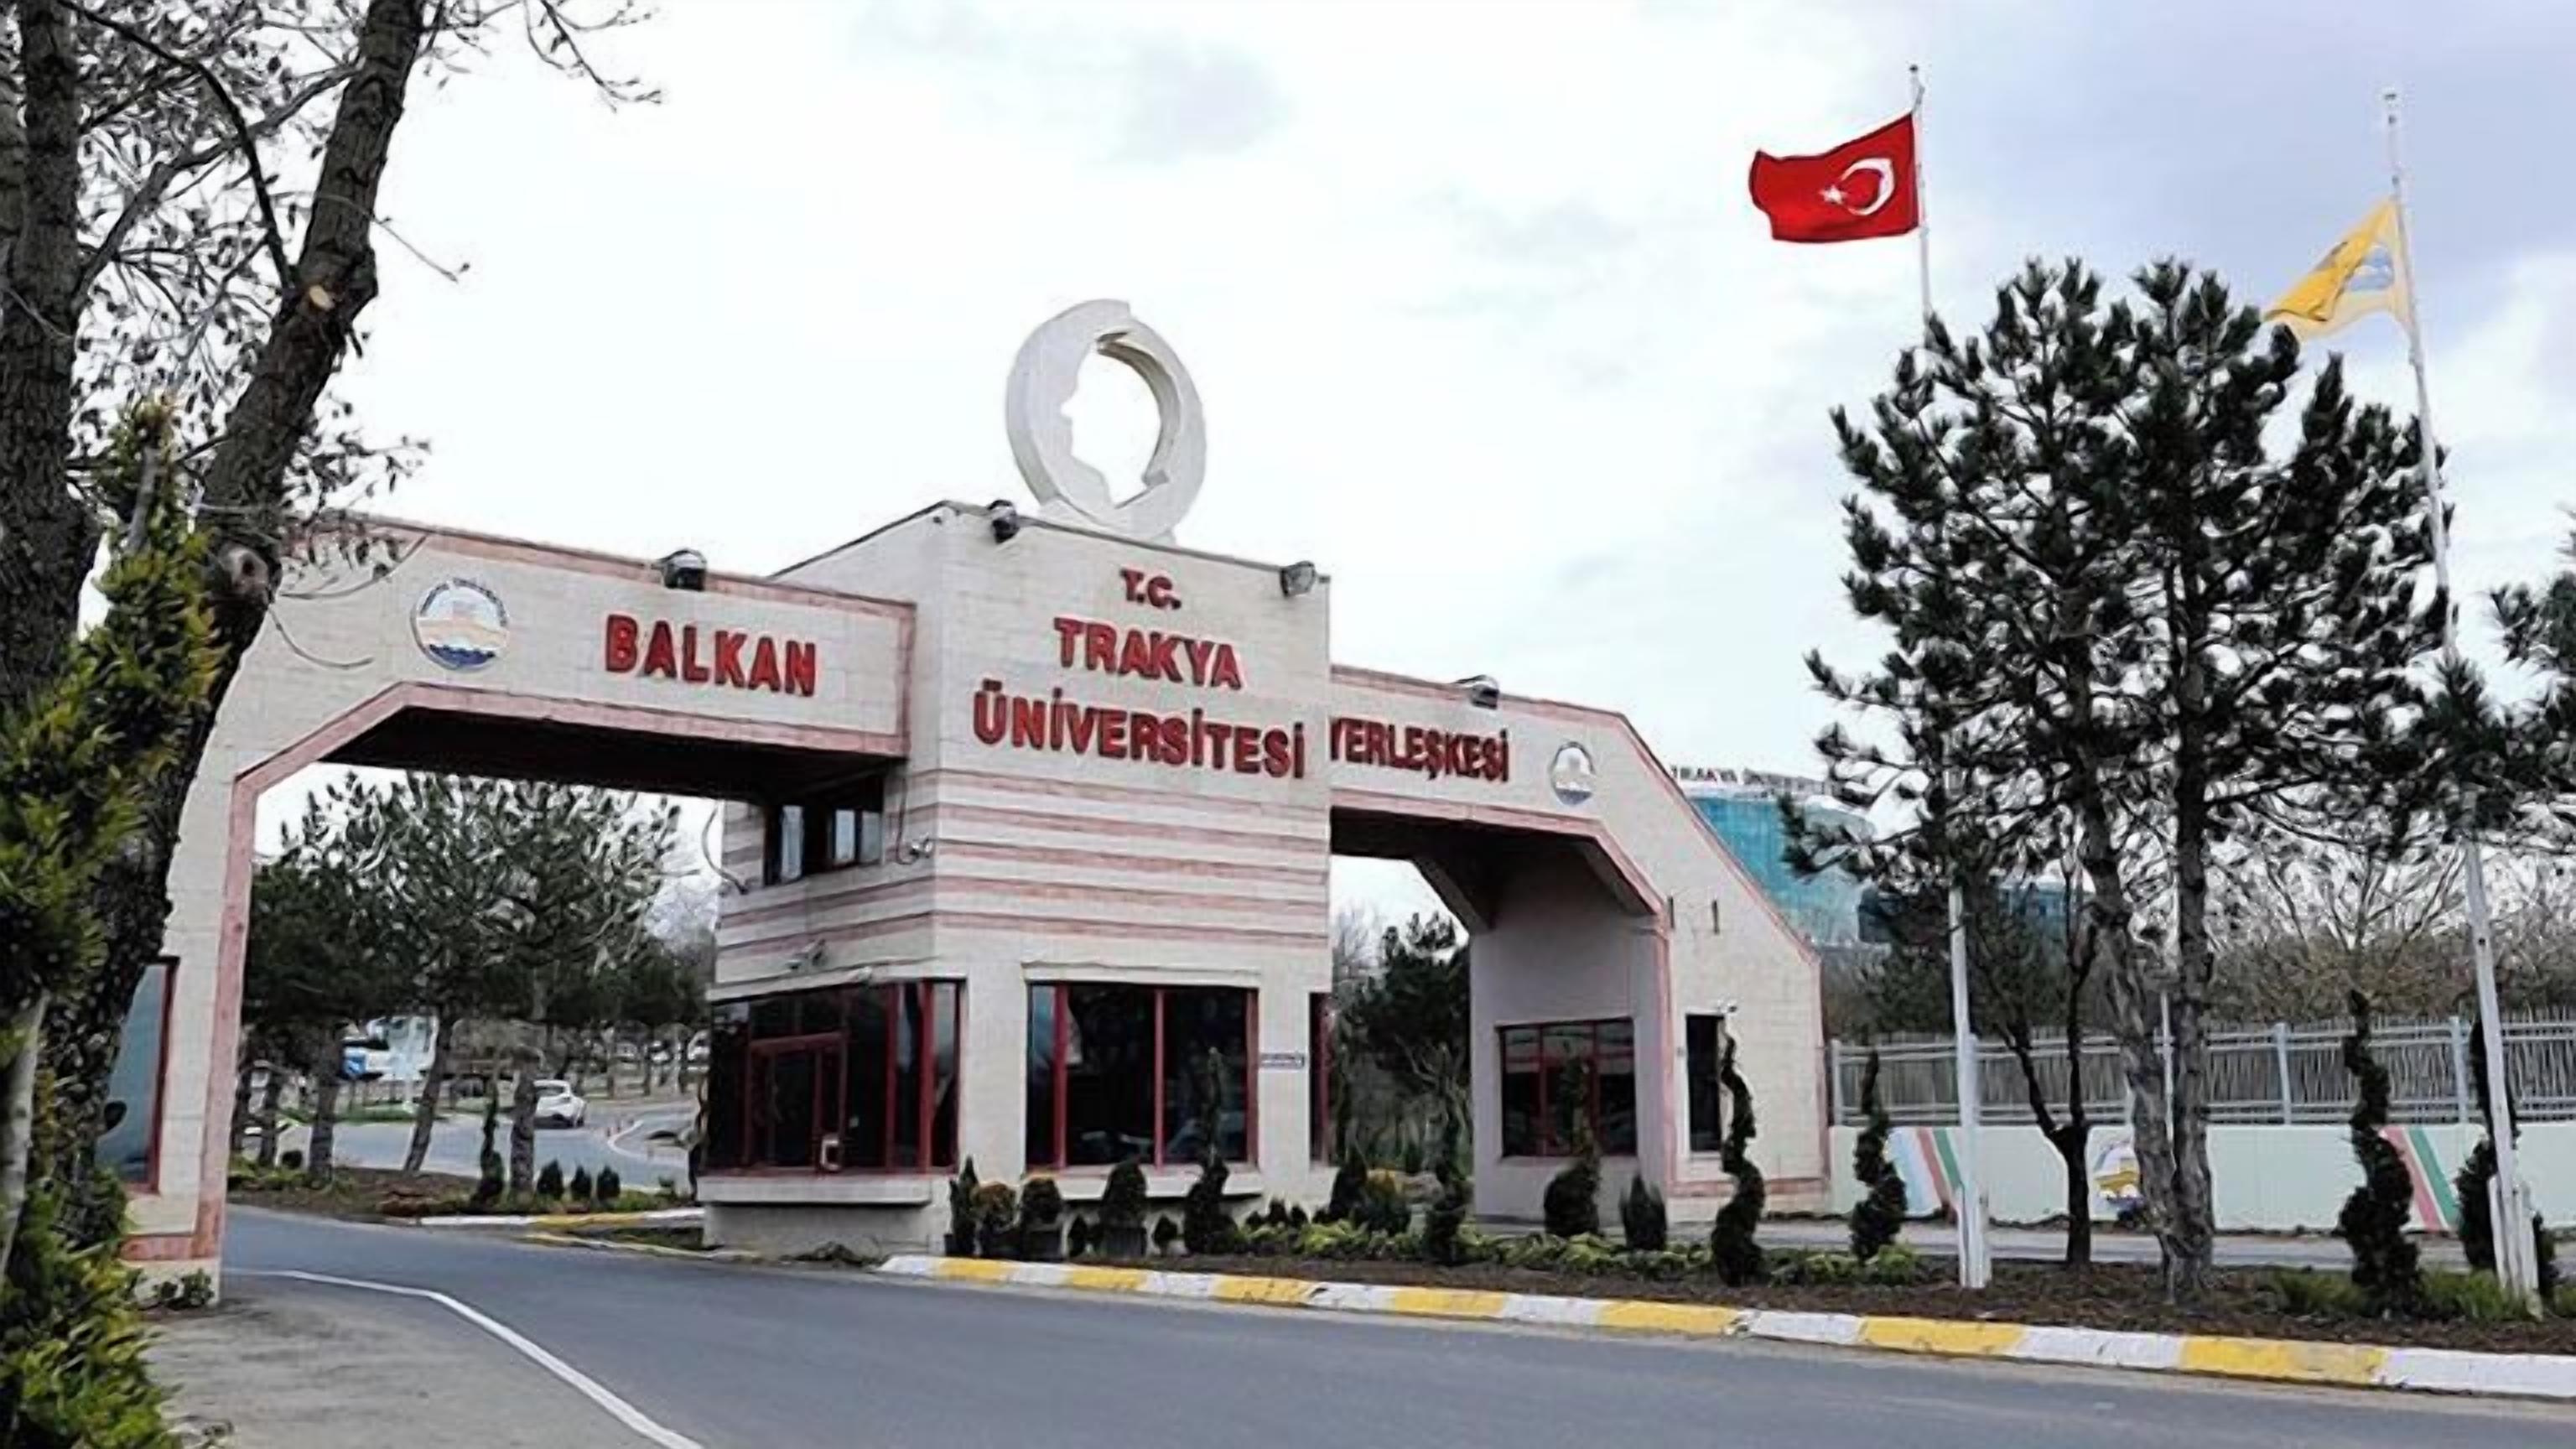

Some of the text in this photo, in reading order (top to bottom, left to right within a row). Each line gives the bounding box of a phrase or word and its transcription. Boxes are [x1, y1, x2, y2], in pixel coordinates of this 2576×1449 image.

[1120, 569, 1182, 610] T.C.
[605, 614, 816, 697] BALKAN
[1053, 617, 1242, 690] TRAKYA
[974, 678, 1304, 778] ÜNİVERSİTESİ
